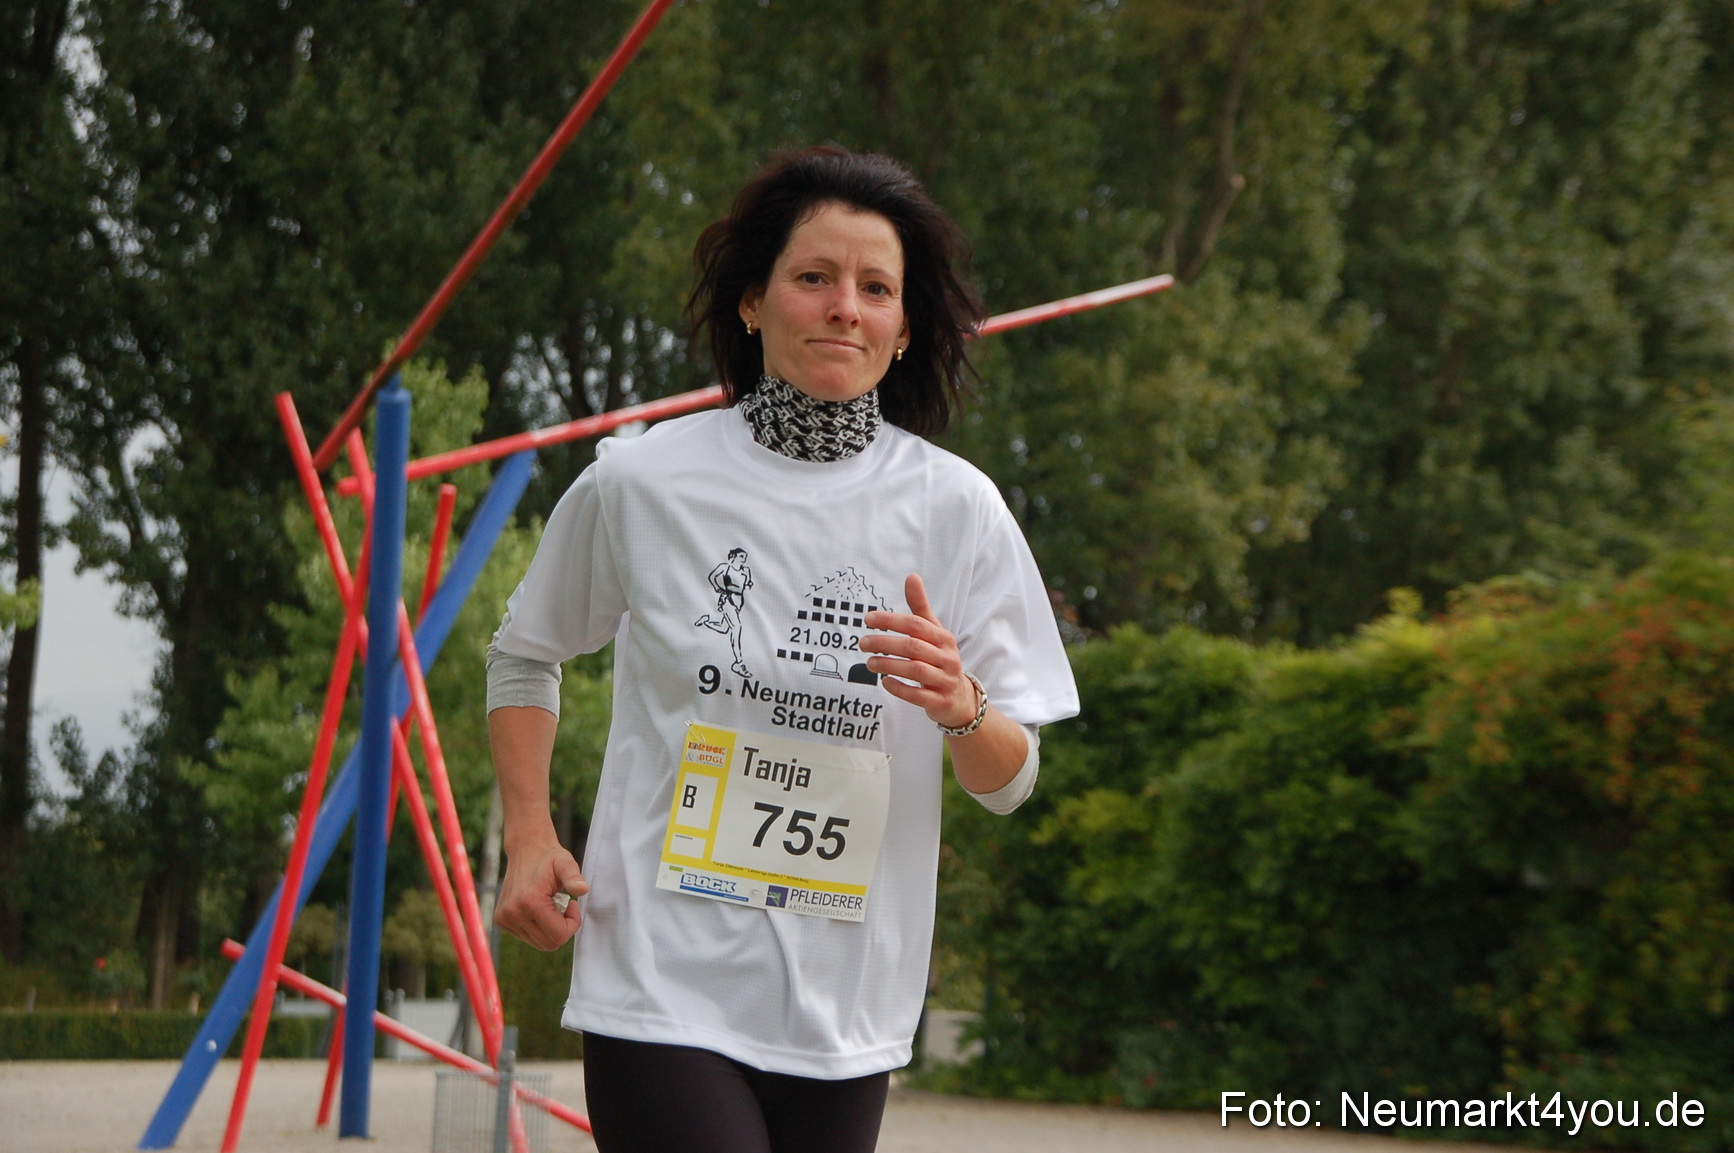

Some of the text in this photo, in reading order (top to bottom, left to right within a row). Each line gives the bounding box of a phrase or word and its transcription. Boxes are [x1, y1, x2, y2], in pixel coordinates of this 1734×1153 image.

[698, 664, 884, 719] 9. Neumarkter
[771, 706, 880, 741] Stadtlauf
[743, 746, 812, 791] Tanja
[682, 784, 698, 808] B
[752, 801, 850, 861] 755
[680, 873, 737, 893] BOCK
[788, 904, 862, 919] AKTIENGESELLSCHAFT
[790, 888, 863, 910] PFLEIDERER
